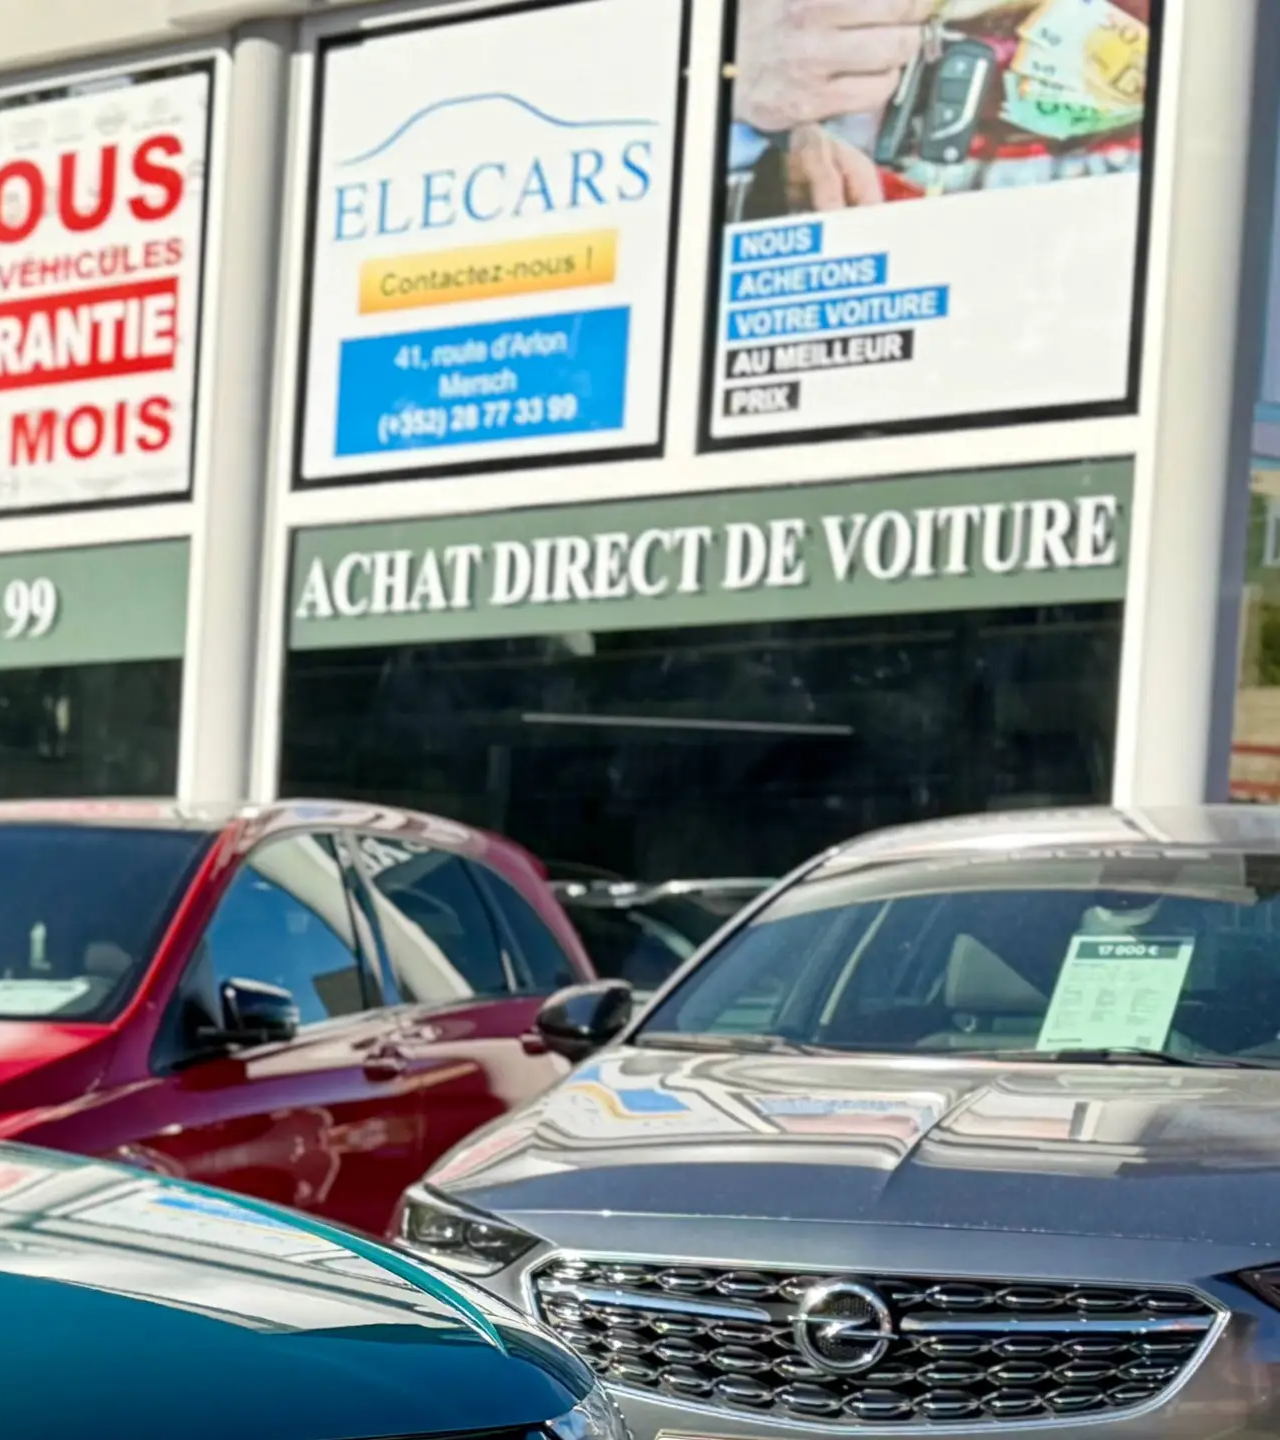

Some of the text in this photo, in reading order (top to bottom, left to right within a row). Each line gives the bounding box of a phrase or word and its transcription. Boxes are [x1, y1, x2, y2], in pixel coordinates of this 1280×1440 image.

[332, 140, 653, 243] ELECARS
[739, 225, 813, 259] NOUS
[379, 246, 595, 298] Contactez-nous !
[737, 257, 877, 299] ACHETONS
[733, 290, 937, 338] VOTRE VOITURE
[431, 338, 487, 367] route
[731, 333, 904, 376] AU MEILLEUR
[437, 366, 518, 399] Mersch
[730, 385, 790, 415] PRIX
[9, 395, 173, 466] MOIS
[482, 400, 511, 428] 77
[294, 494, 1118, 618] ACHAT DIRECT DE VOITURE
[3, 576, 58, 639] 99
